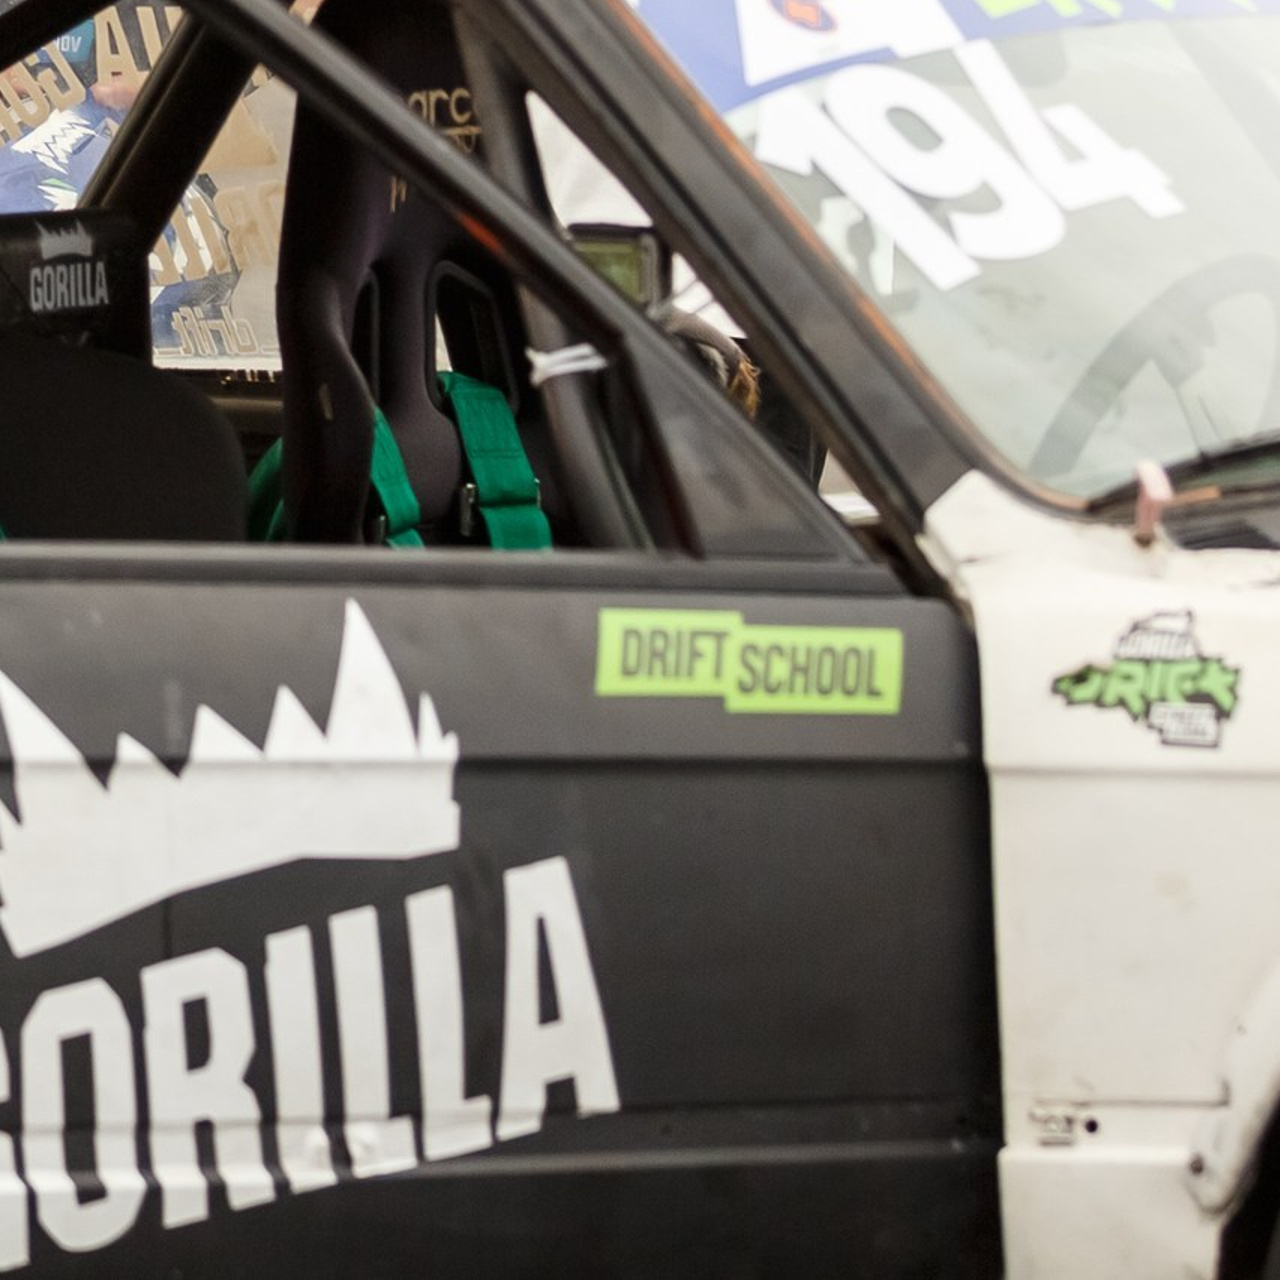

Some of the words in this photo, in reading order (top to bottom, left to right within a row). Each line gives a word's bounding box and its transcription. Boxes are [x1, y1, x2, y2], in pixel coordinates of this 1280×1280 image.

[754, 37, 1187, 292] 194
[30, 261, 109, 312] GORILLA
[622, 628, 731, 682] DRIFT
[738, 641, 883, 699] SCHOOL
